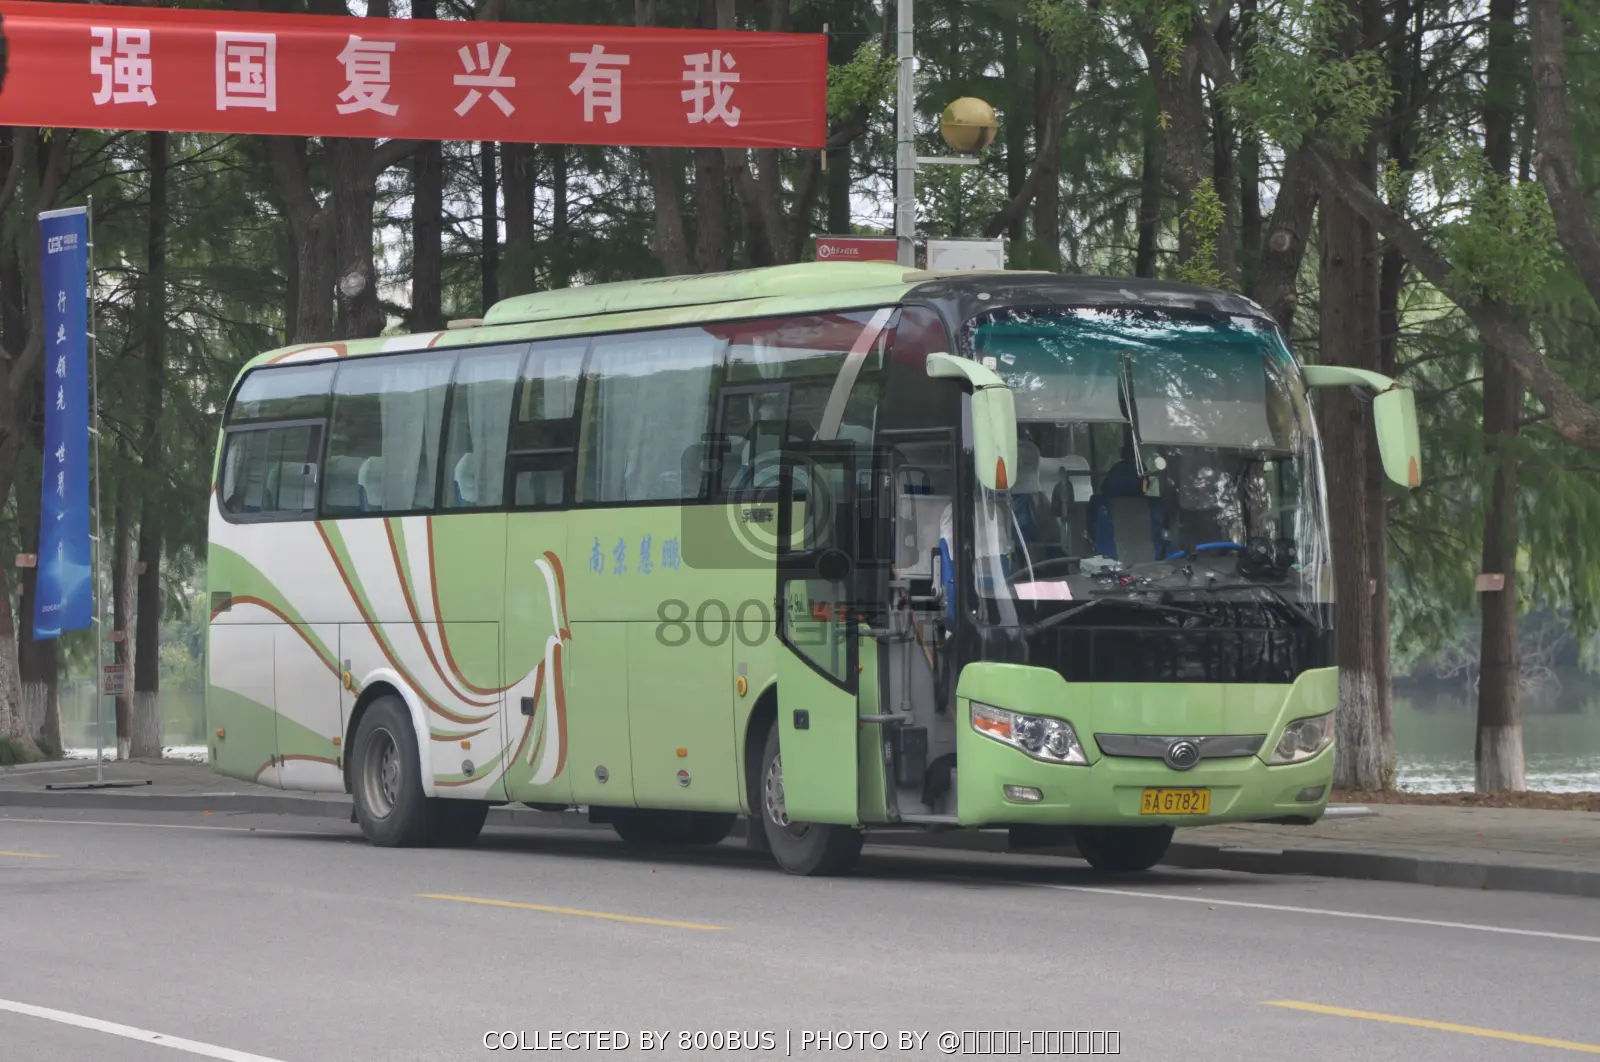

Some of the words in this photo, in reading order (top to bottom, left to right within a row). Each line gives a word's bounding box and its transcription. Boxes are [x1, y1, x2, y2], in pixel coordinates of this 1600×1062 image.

[90, 27, 741, 127] 强国复兴有我
